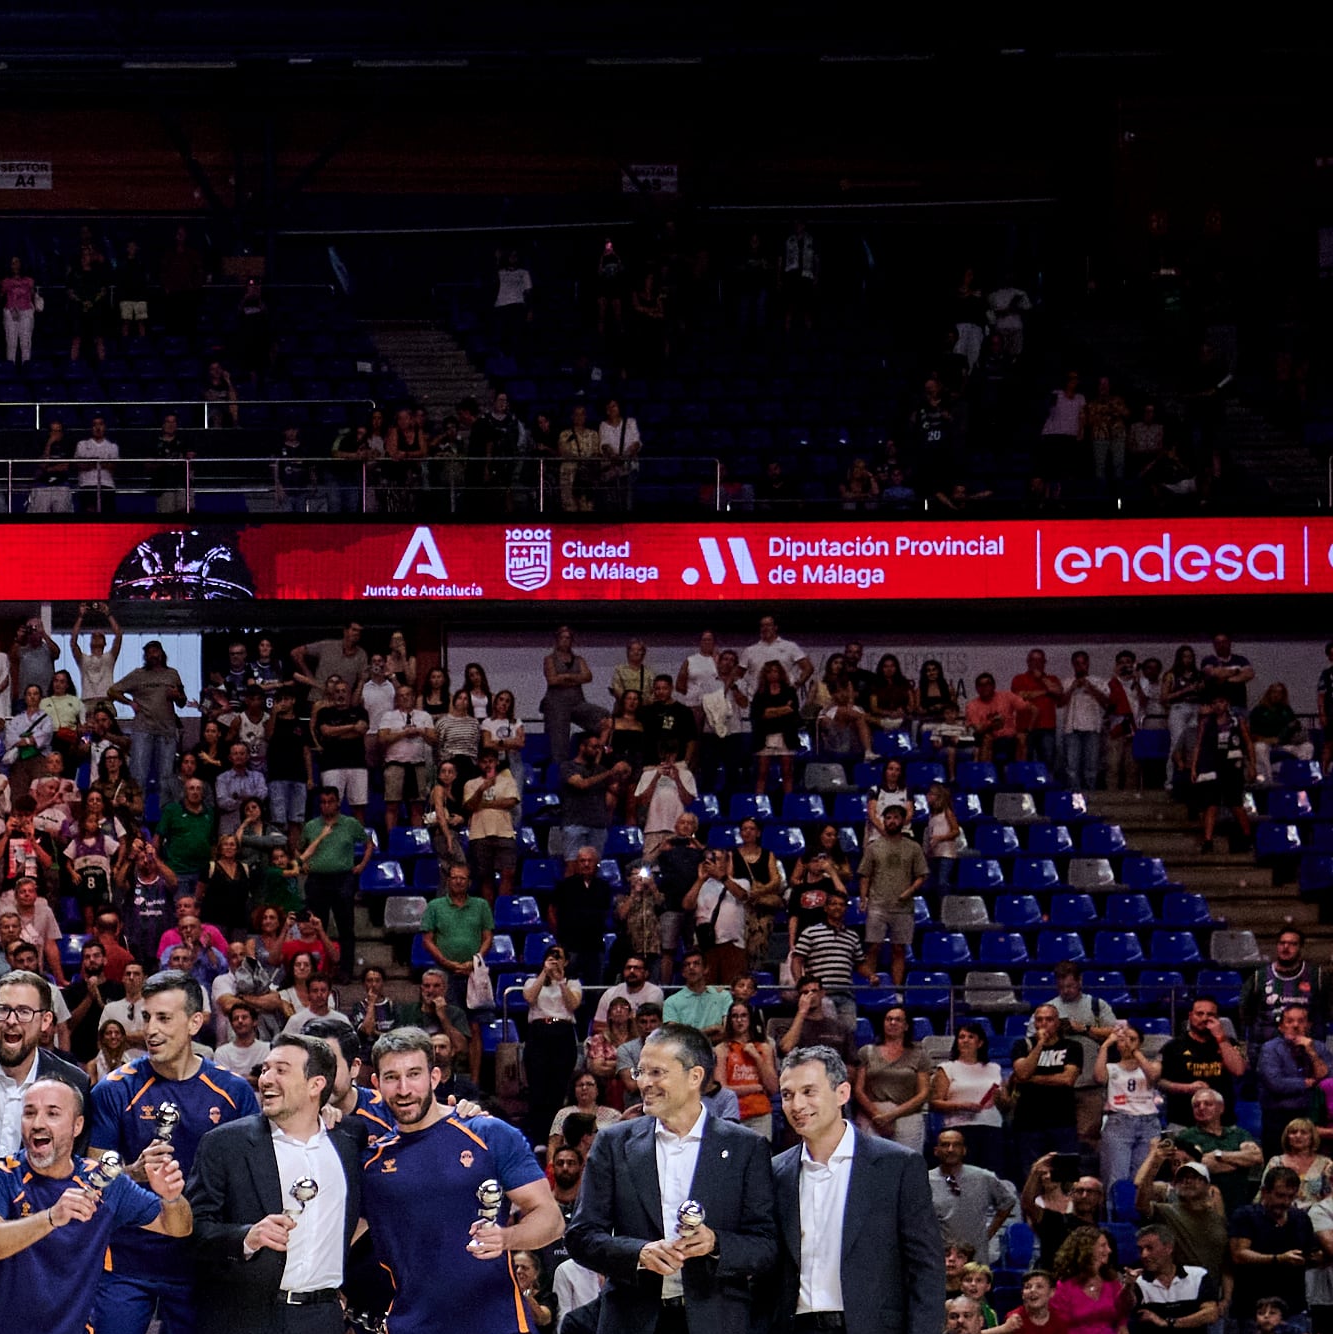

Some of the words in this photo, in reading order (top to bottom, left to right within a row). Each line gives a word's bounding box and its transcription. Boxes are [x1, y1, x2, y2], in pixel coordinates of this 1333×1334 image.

[15, 175, 35, 187] A4
[562, 541, 629, 557] Ciudad
[769, 536, 889, 559] Diputación
[896, 536, 1003, 555] Provincial
[1054, 533, 1284, 583] endesa
[562, 563, 585, 579] de
[591, 562, 658, 583] Málaga
[769, 566, 796, 584] de
[803, 564, 884, 588] Málaga
[363, 585, 398, 596] Junta
[402, 584, 417, 596] de
[419, 583, 482, 596] Andalucía
